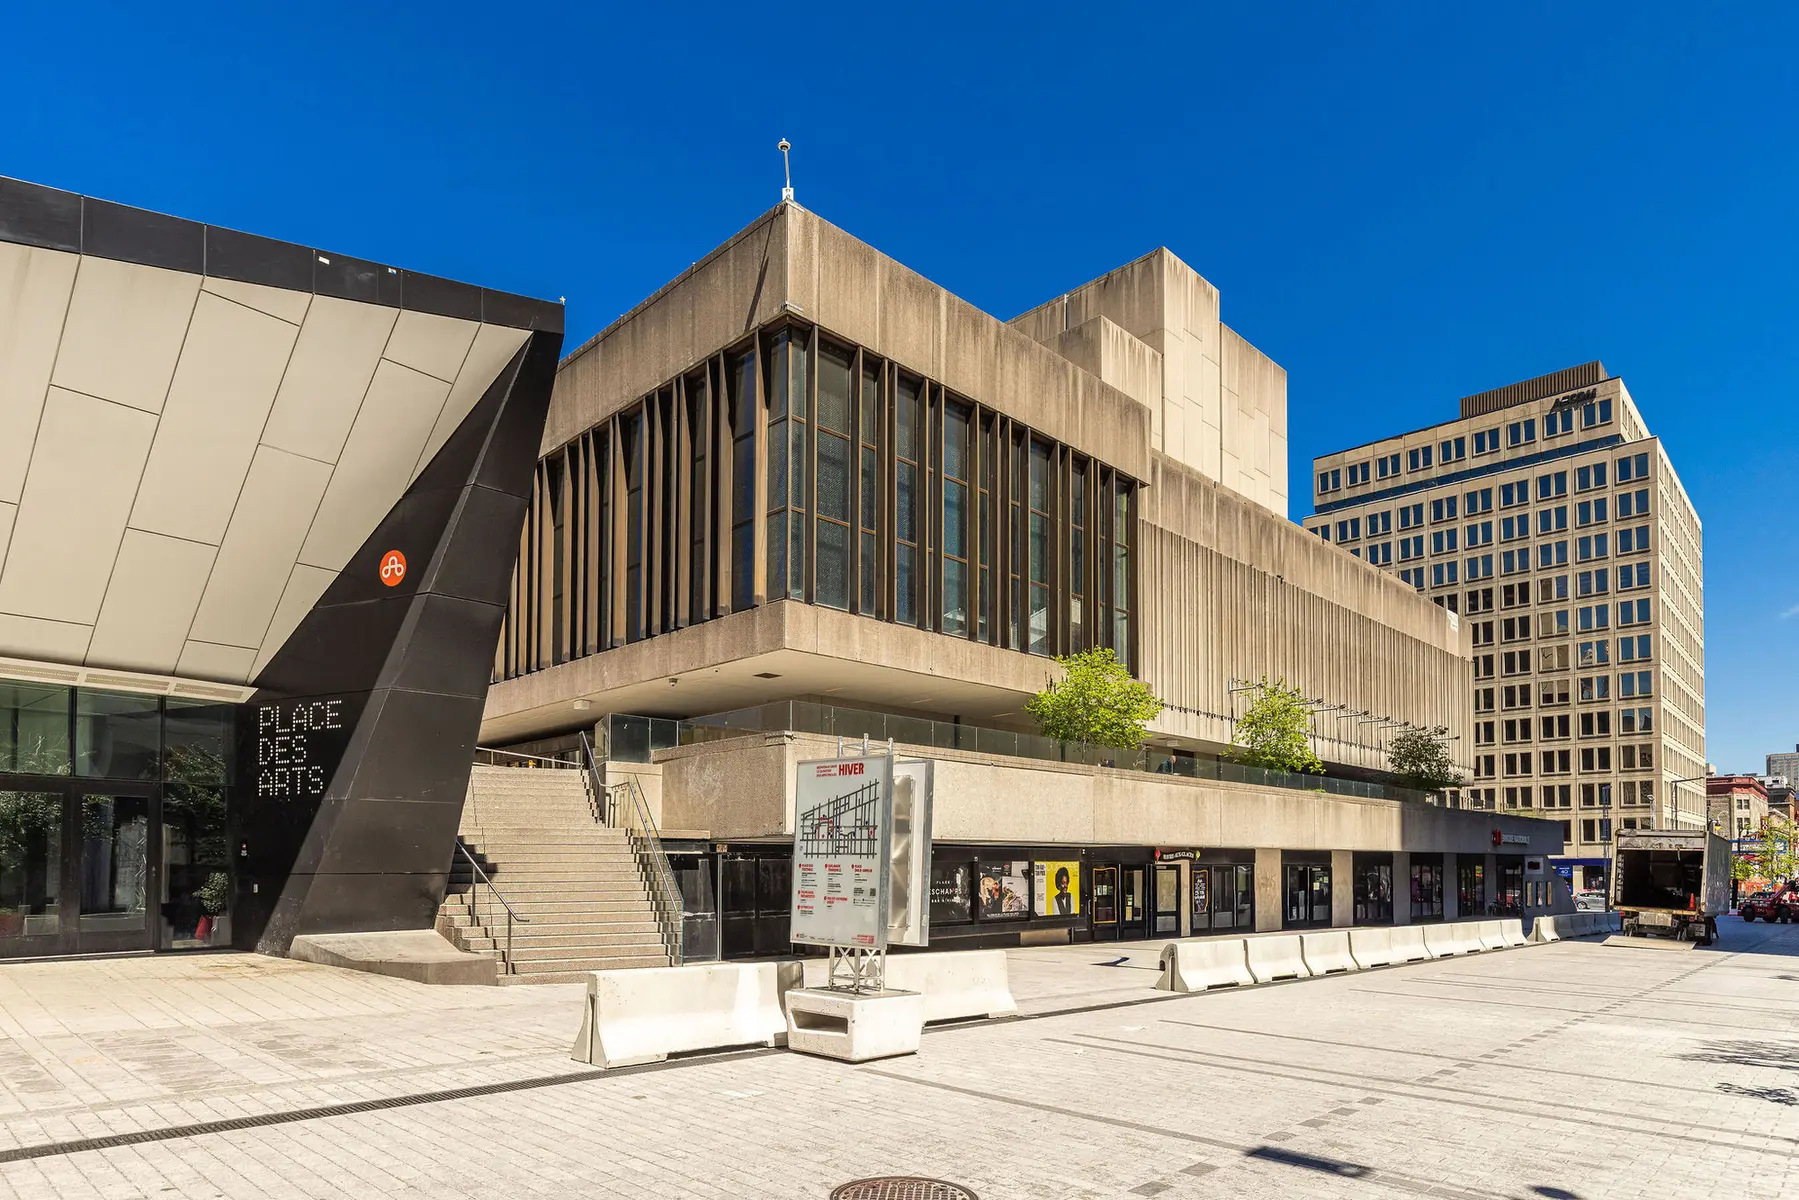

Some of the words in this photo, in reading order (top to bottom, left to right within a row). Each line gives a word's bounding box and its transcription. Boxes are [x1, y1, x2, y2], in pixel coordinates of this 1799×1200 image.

[260, 700, 342, 734] PLACE
[259, 735, 307, 765] DES
[259, 766, 324, 796] ARTS
[838, 763, 865, 776] HIVER
